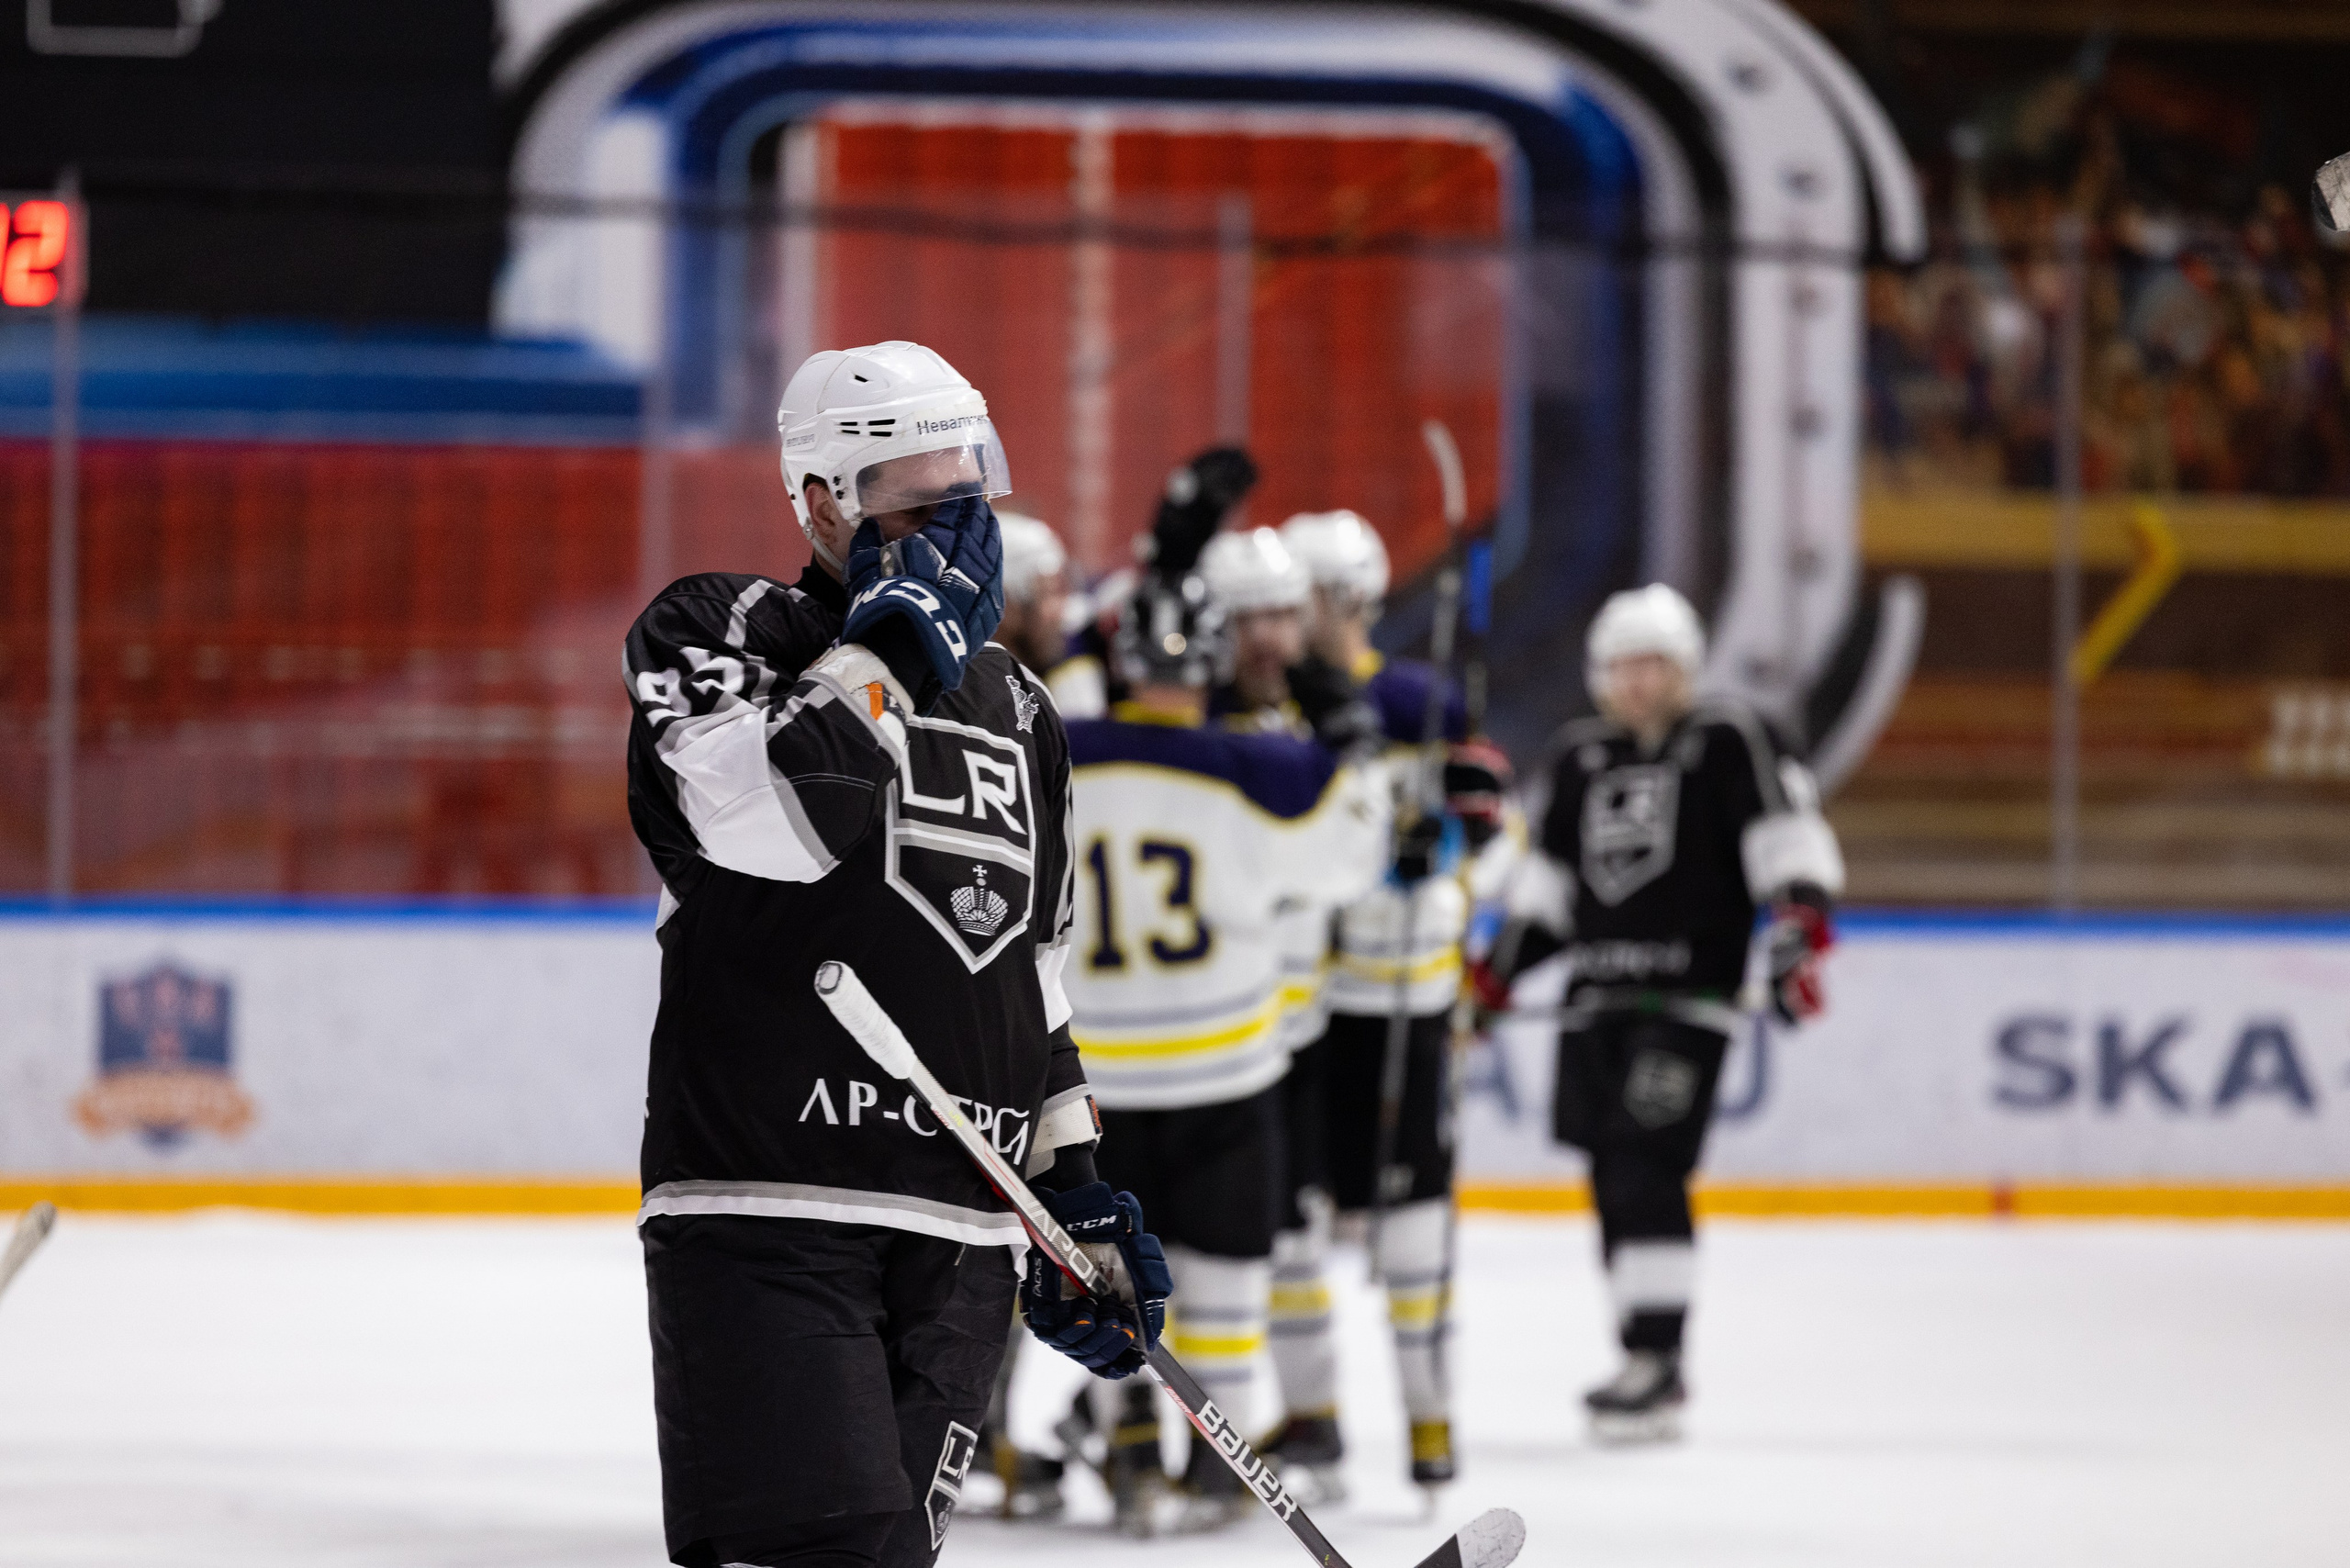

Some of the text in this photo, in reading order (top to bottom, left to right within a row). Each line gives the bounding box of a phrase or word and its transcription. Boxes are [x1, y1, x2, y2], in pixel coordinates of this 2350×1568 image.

[901, 740, 1028, 835] LR
[1085, 835, 1214, 973] 13
[1066, 1215, 1117, 1232] CCM
[1196, 1399, 1298, 1522] BAUER
